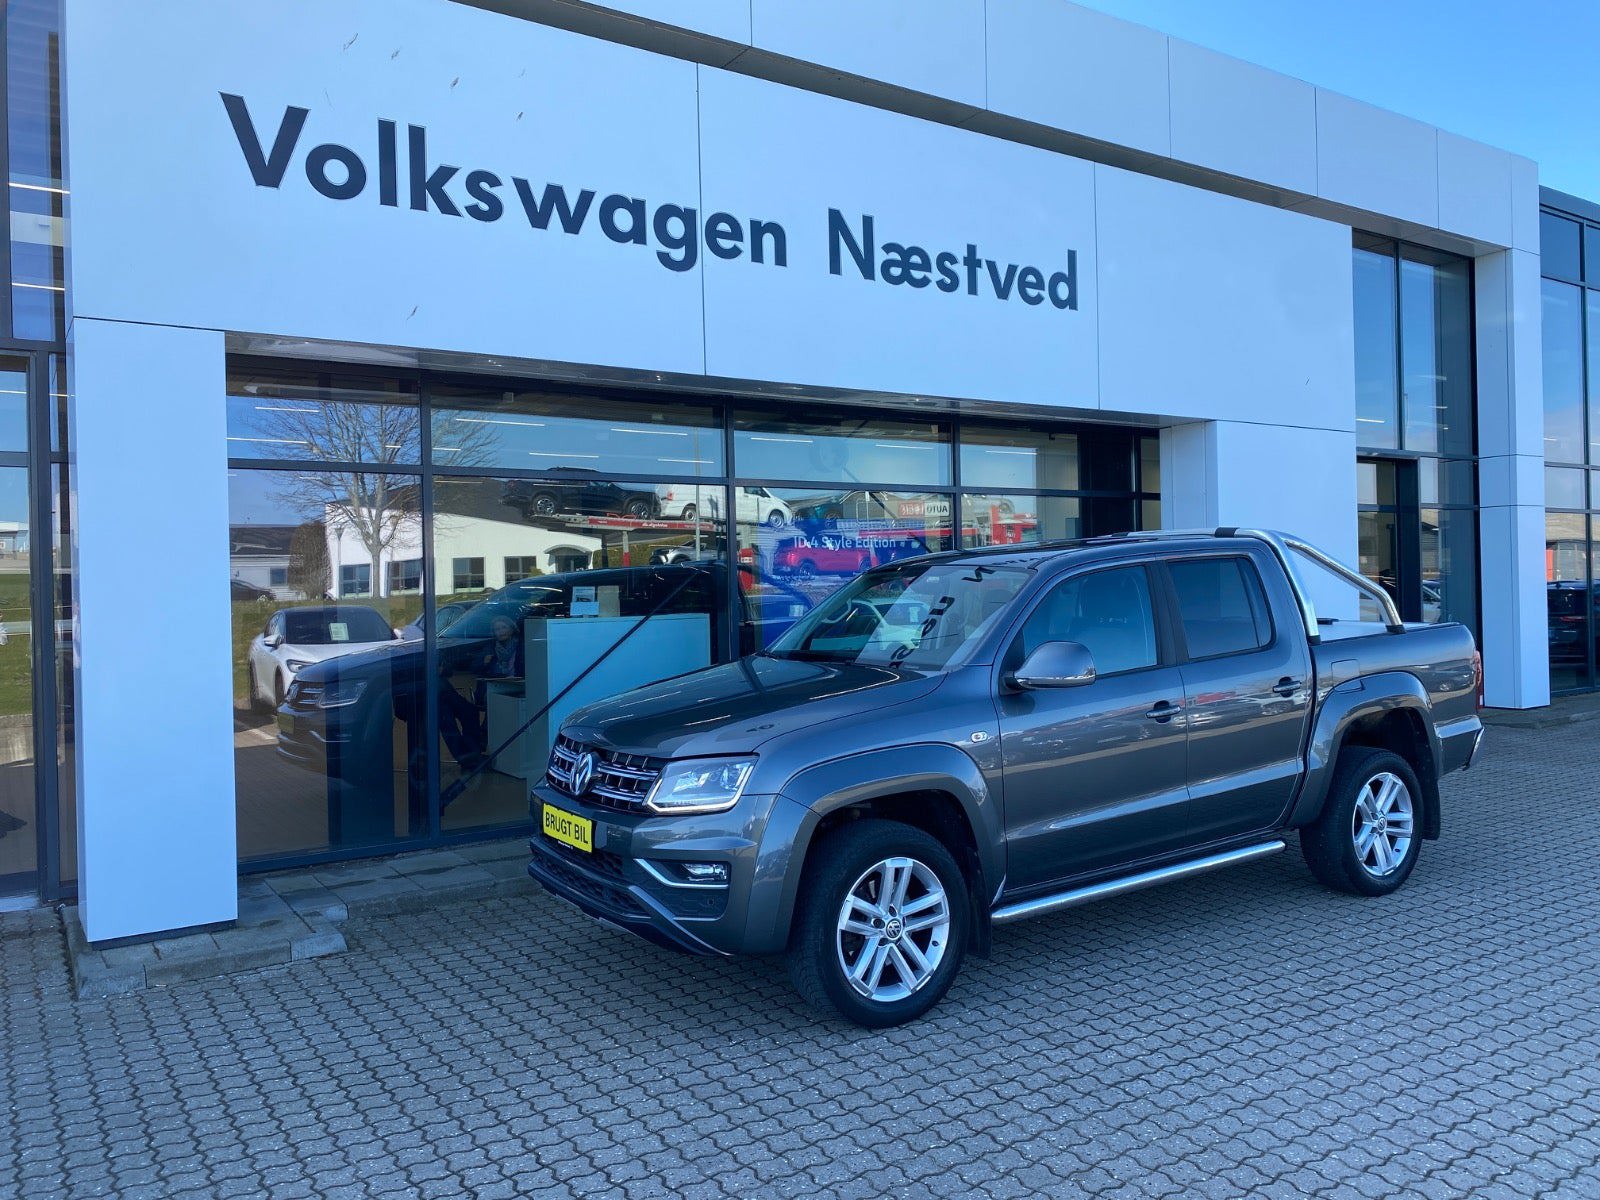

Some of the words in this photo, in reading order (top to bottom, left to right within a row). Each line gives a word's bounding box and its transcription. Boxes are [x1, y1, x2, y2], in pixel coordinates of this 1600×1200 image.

[218, 91, 788, 273] Volkswagen
[827, 207, 1079, 311] Næstved
[821, 536, 853, 551] Style
[855, 536, 897, 549] Edition
[545, 811, 572, 837] BRUGT
[574, 823, 589, 845] BIL
